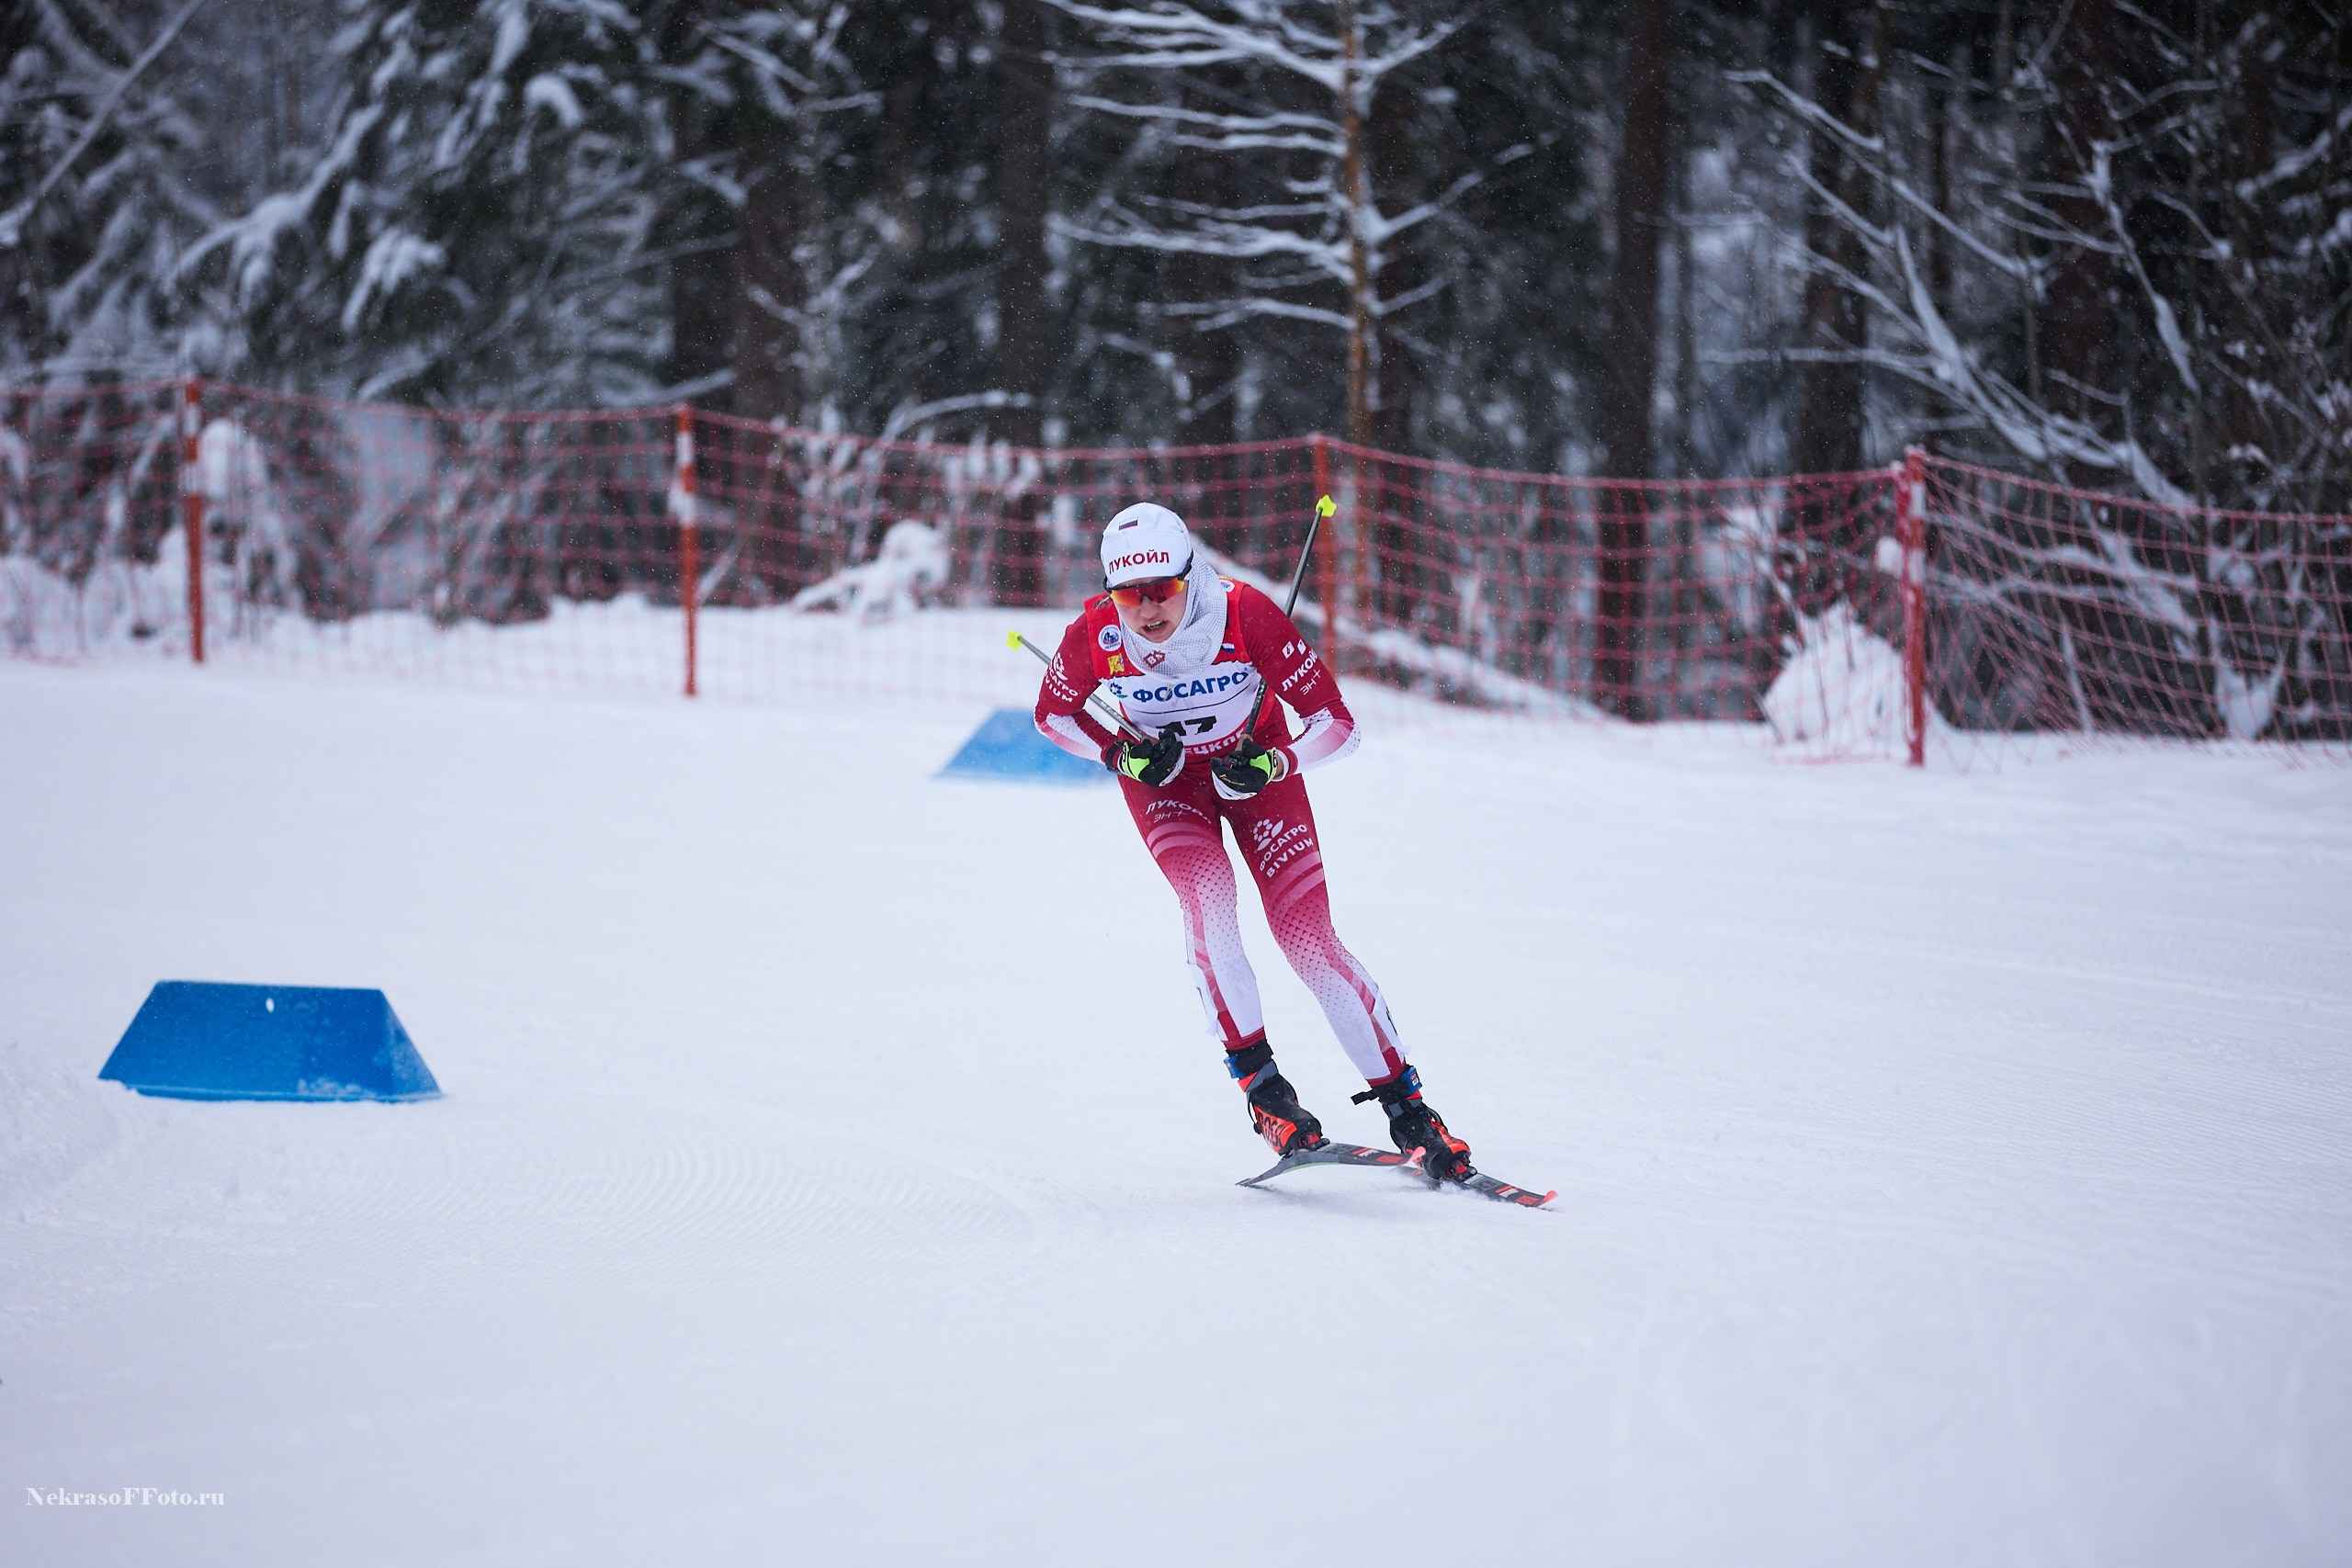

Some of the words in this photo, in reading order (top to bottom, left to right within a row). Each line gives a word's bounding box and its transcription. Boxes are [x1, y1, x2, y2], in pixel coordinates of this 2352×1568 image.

[1109, 549, 1170, 574] ЛУКОЙЛ
[1132, 671, 1249, 703] ФОСАГРО
[1260, 824, 1307, 872] ФОСАГРО
[1266, 837, 1314, 878] BIVIUM
